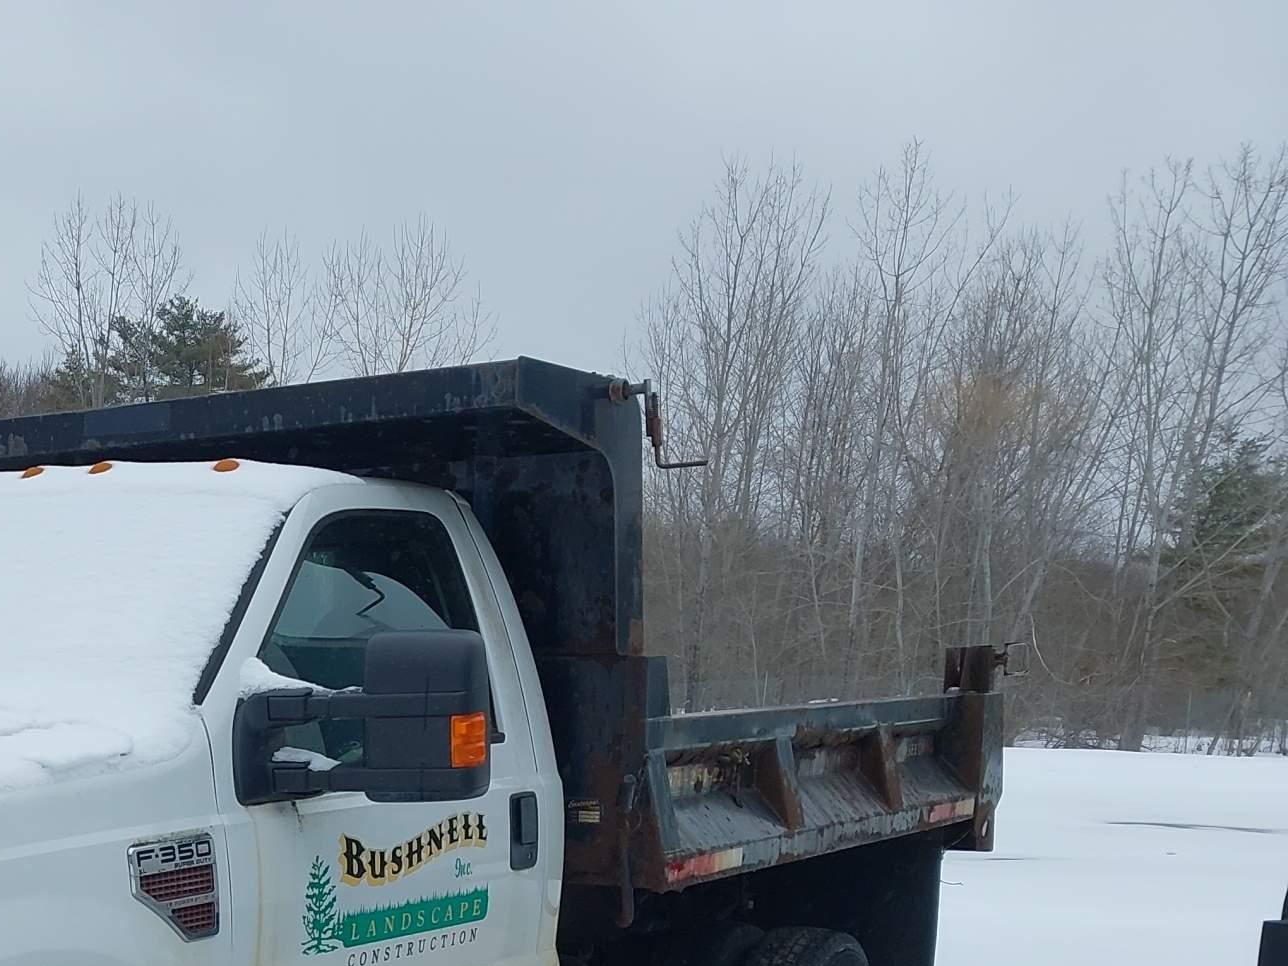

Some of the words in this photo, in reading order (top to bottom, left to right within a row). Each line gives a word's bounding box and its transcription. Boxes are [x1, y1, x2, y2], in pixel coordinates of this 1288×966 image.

[136, 839, 212, 868] F-350
[455, 857, 473, 878] Inc.
[350, 899, 482, 941] LANDSCAPE
